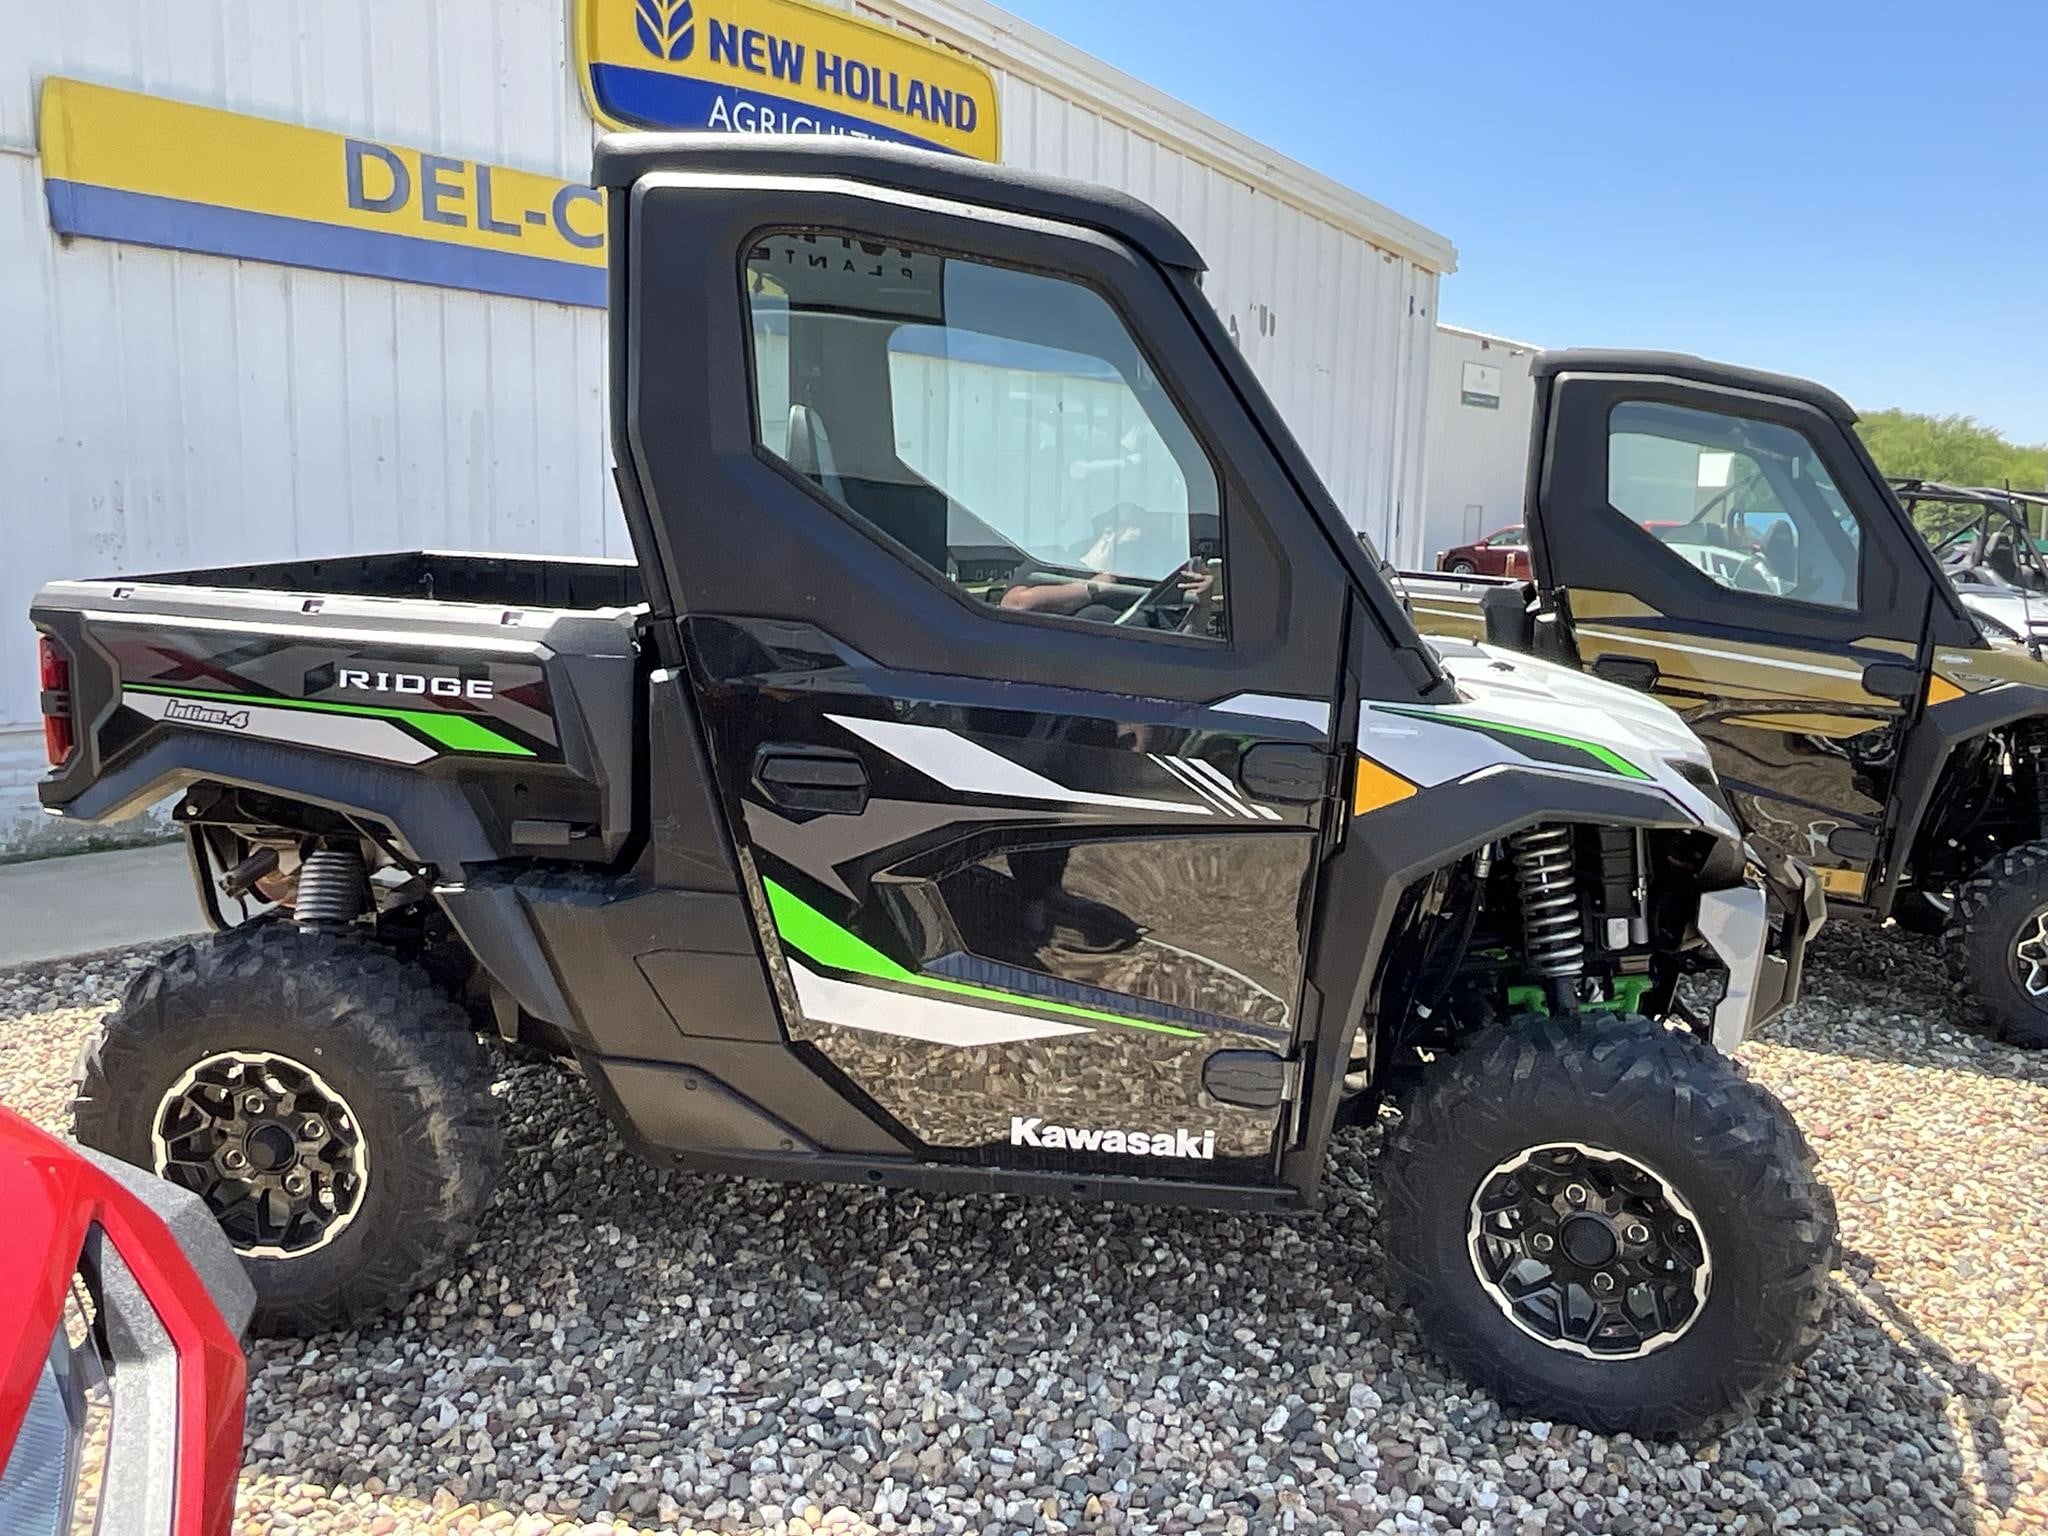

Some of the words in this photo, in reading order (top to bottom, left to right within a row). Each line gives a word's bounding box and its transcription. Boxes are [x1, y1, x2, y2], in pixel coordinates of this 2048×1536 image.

[709, 18, 805, 85] NEW
[816, 49, 978, 133] HOLLAND
[339, 669, 494, 700] RIDGE
[164, 699, 250, 729] Inline-4
[1010, 1116, 1216, 1160] Kawasaki
